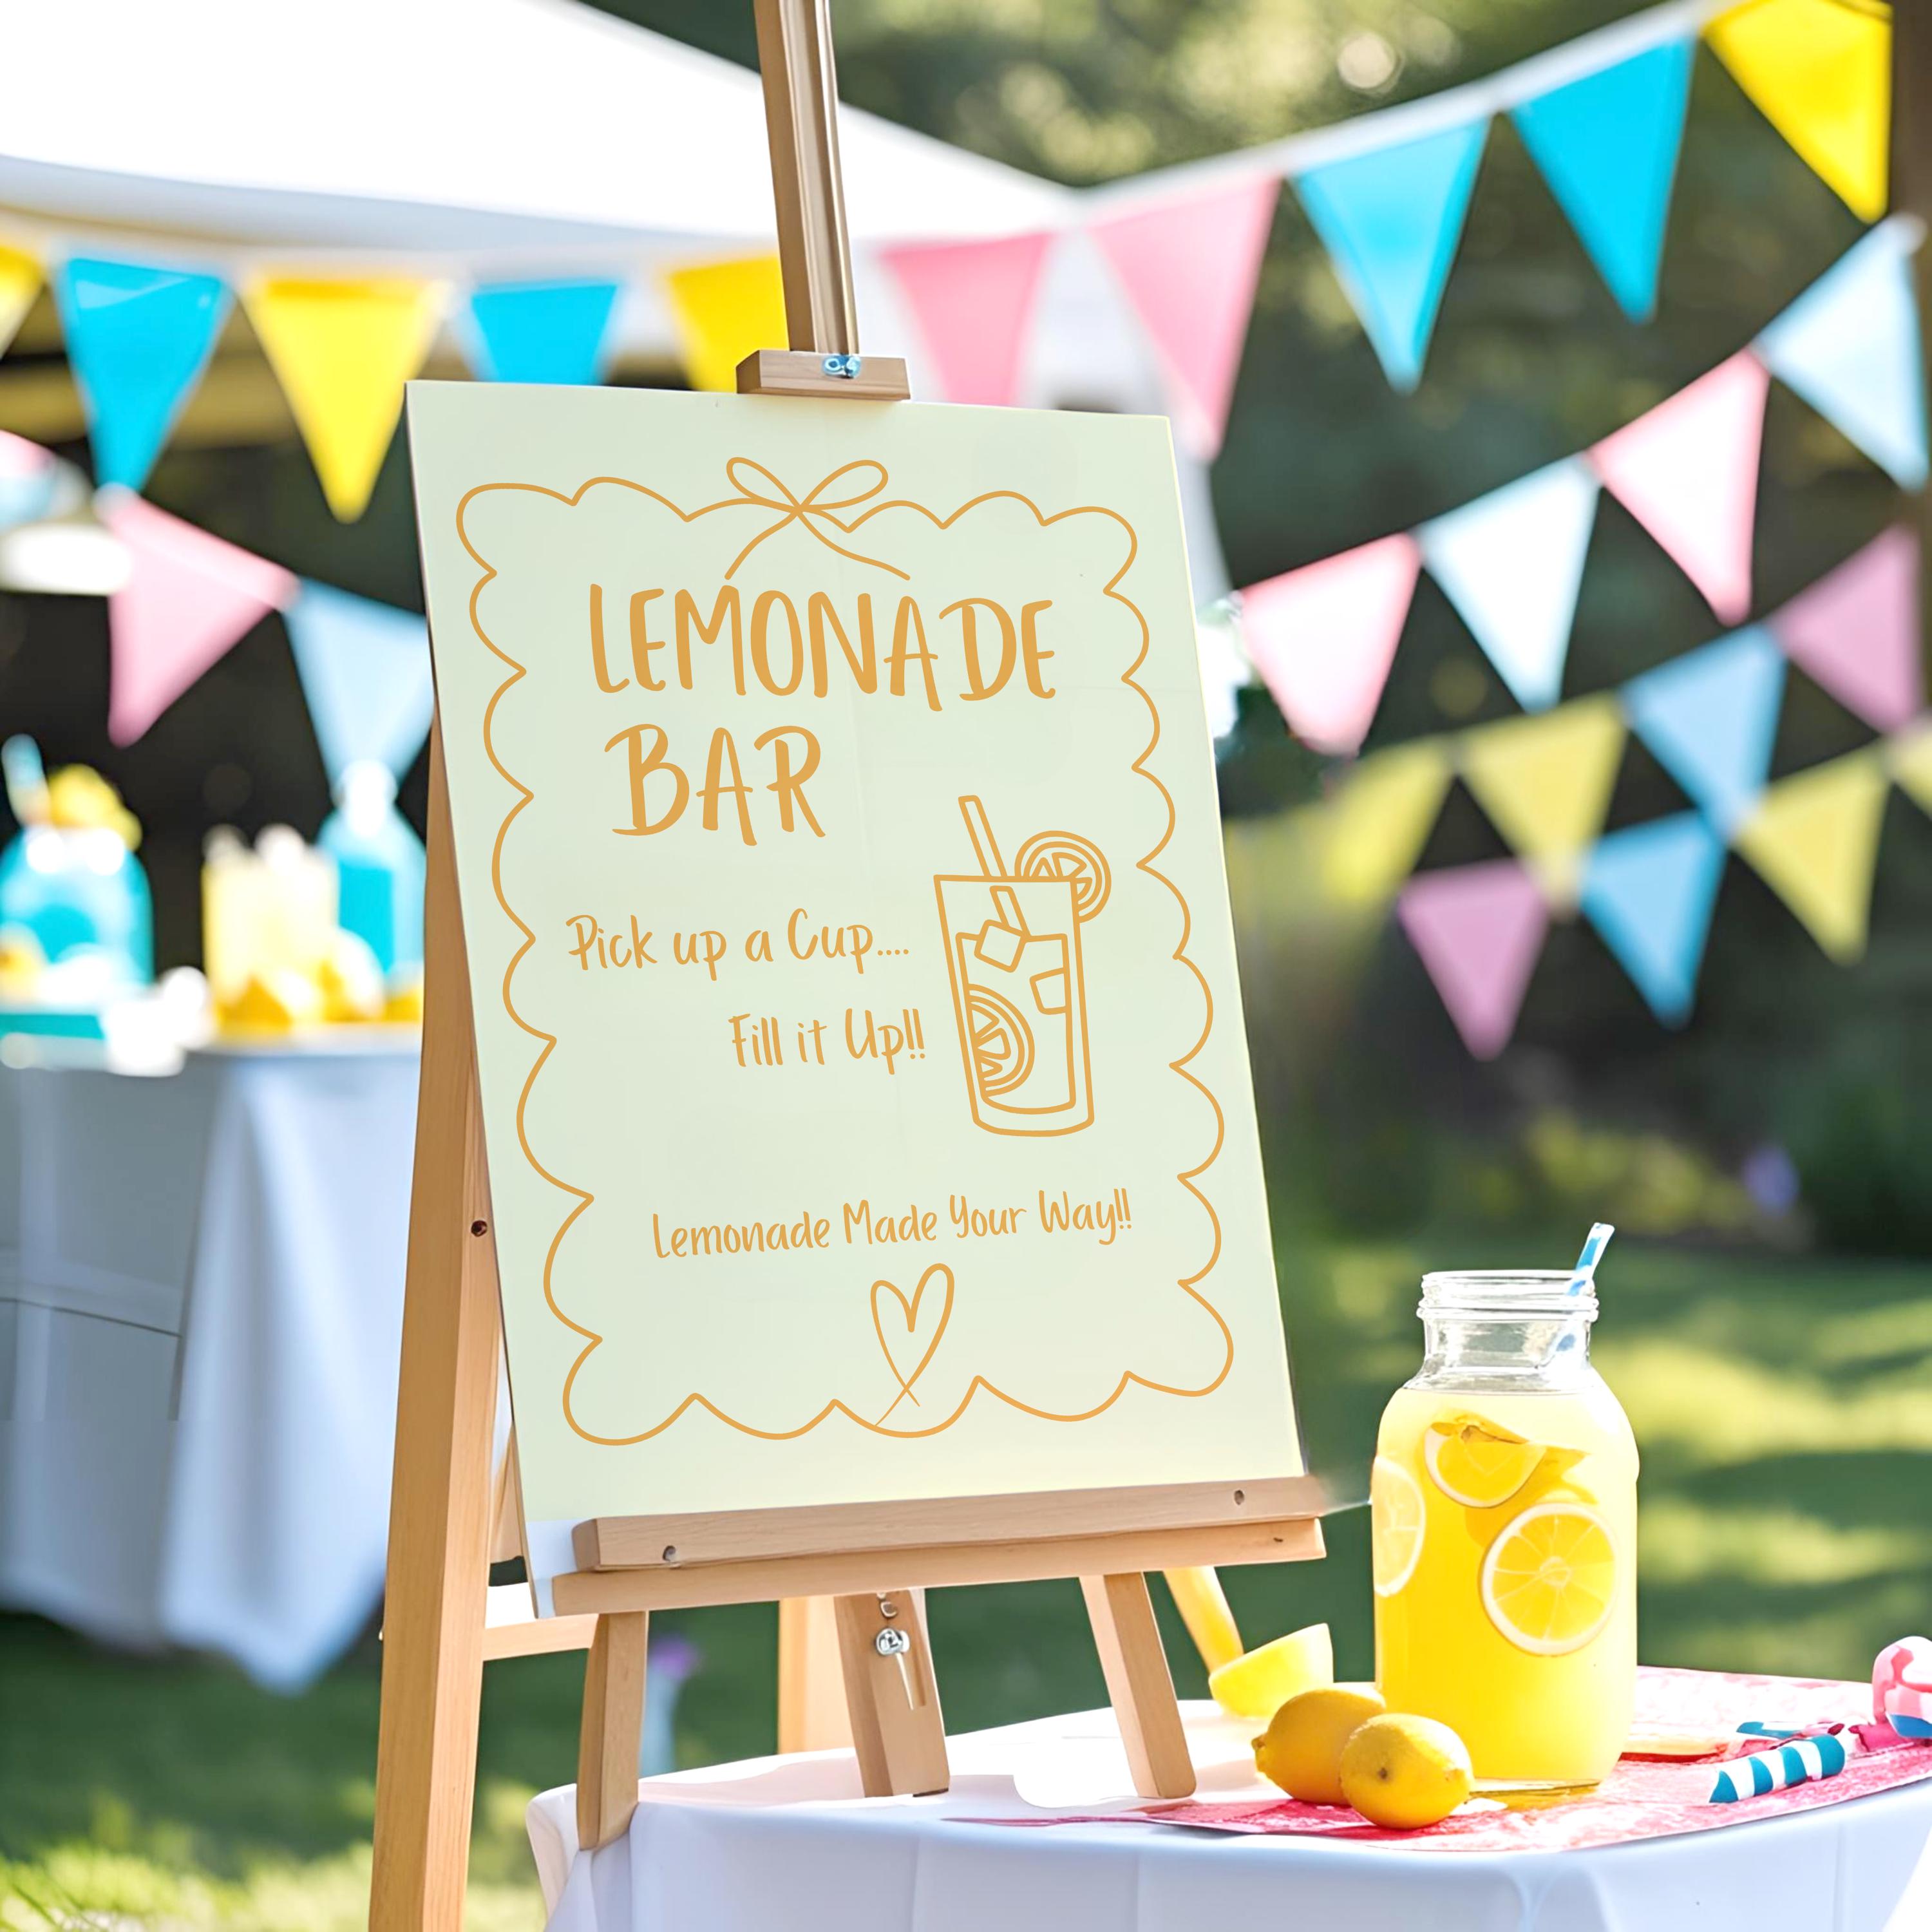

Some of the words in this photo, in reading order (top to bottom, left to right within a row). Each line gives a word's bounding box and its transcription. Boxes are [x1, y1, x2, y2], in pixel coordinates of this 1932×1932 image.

[589, 583, 1057, 712] LEMONADE
[604, 723, 826, 846] BAR
[565, 914, 658, 971] Pick
[673, 930, 728, 982] up
[744, 929, 773, 962] a
[728, 1013, 784, 1068] Fill
[797, 1019, 828, 1066] it
[844, 1007, 926, 1075] Up!!
[652, 1211, 831, 1258] Lemonade
[843, 1199, 938, 1245] Made
[949, 1195, 1027, 1239] Your
[1038, 1188, 1133, 1245] Way!!
